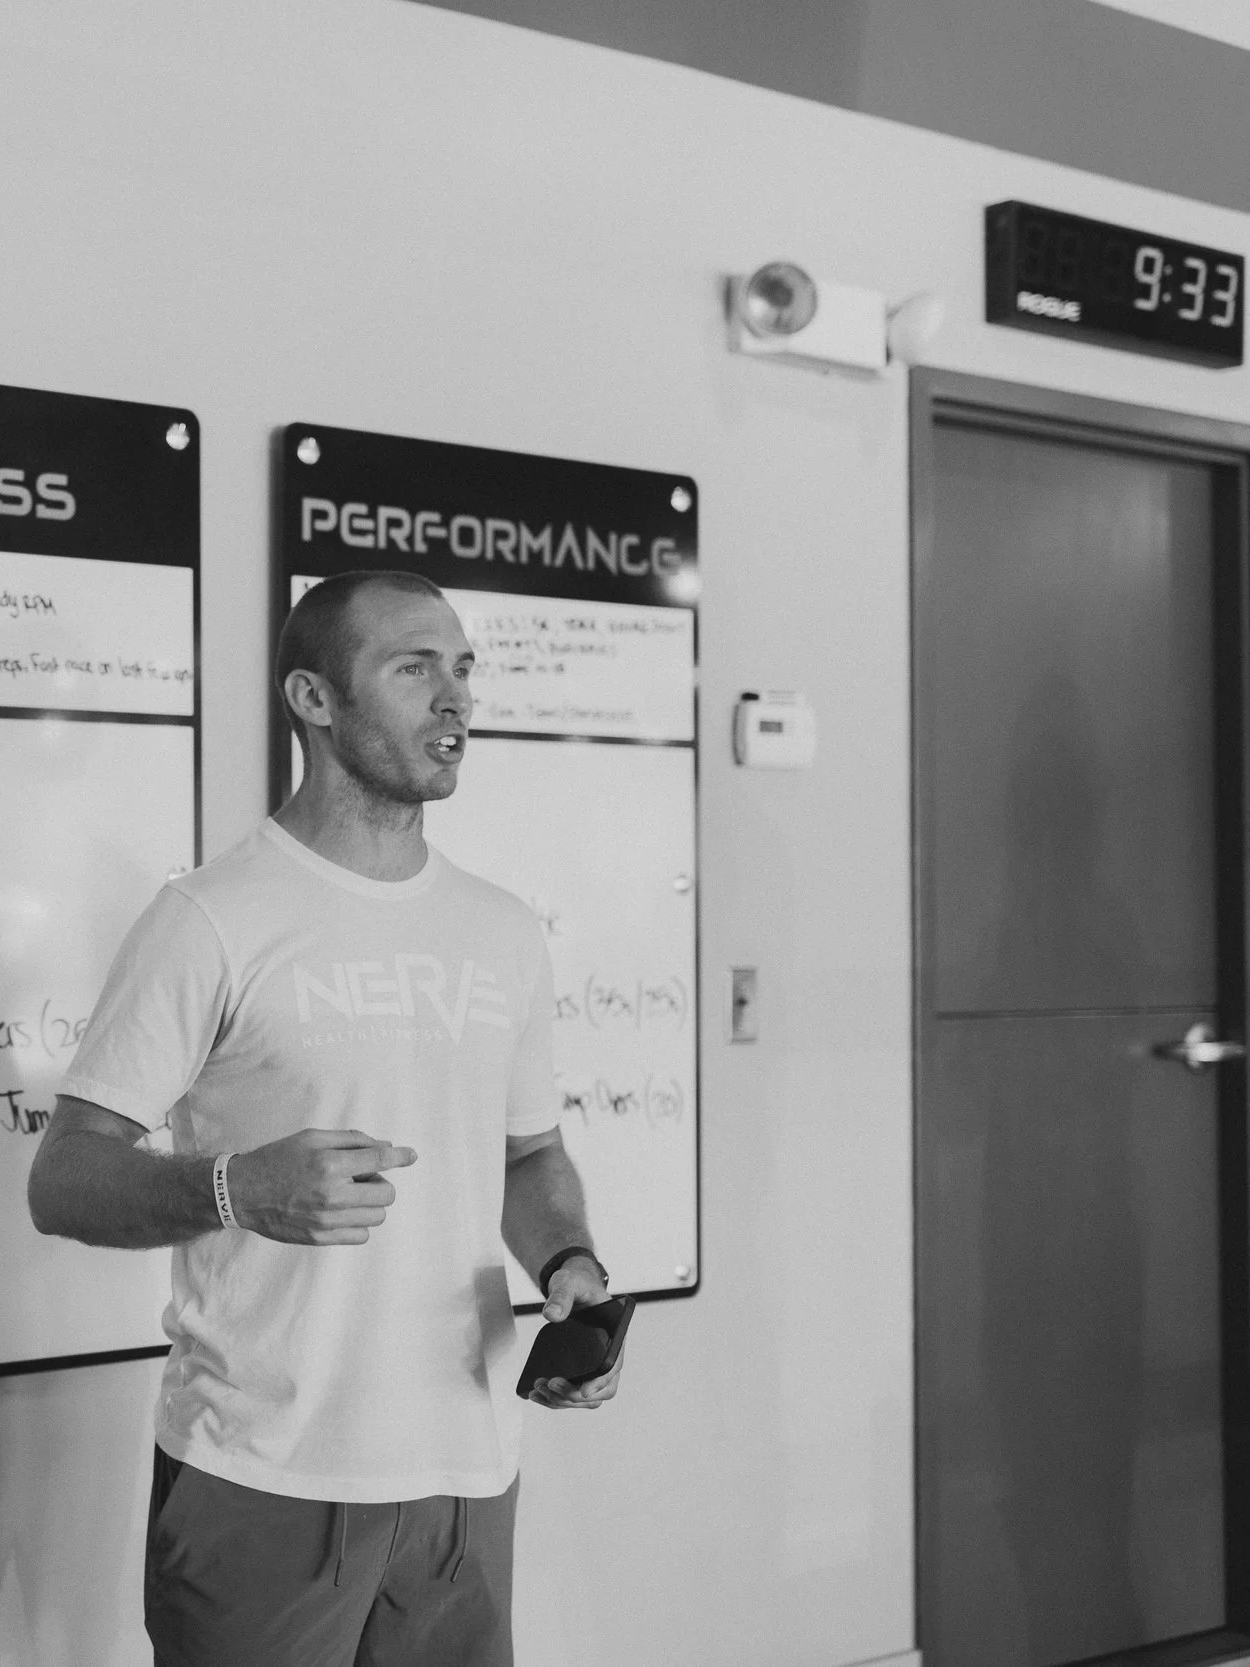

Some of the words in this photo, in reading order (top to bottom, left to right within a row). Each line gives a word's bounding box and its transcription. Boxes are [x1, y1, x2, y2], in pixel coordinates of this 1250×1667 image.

[1134, 246, 1238, 327] 9:33
[301, 497, 682, 577] PERFORMANCE
[292, 952, 512, 1047] NERVE
[217, 1170, 231, 1221] NERVE
